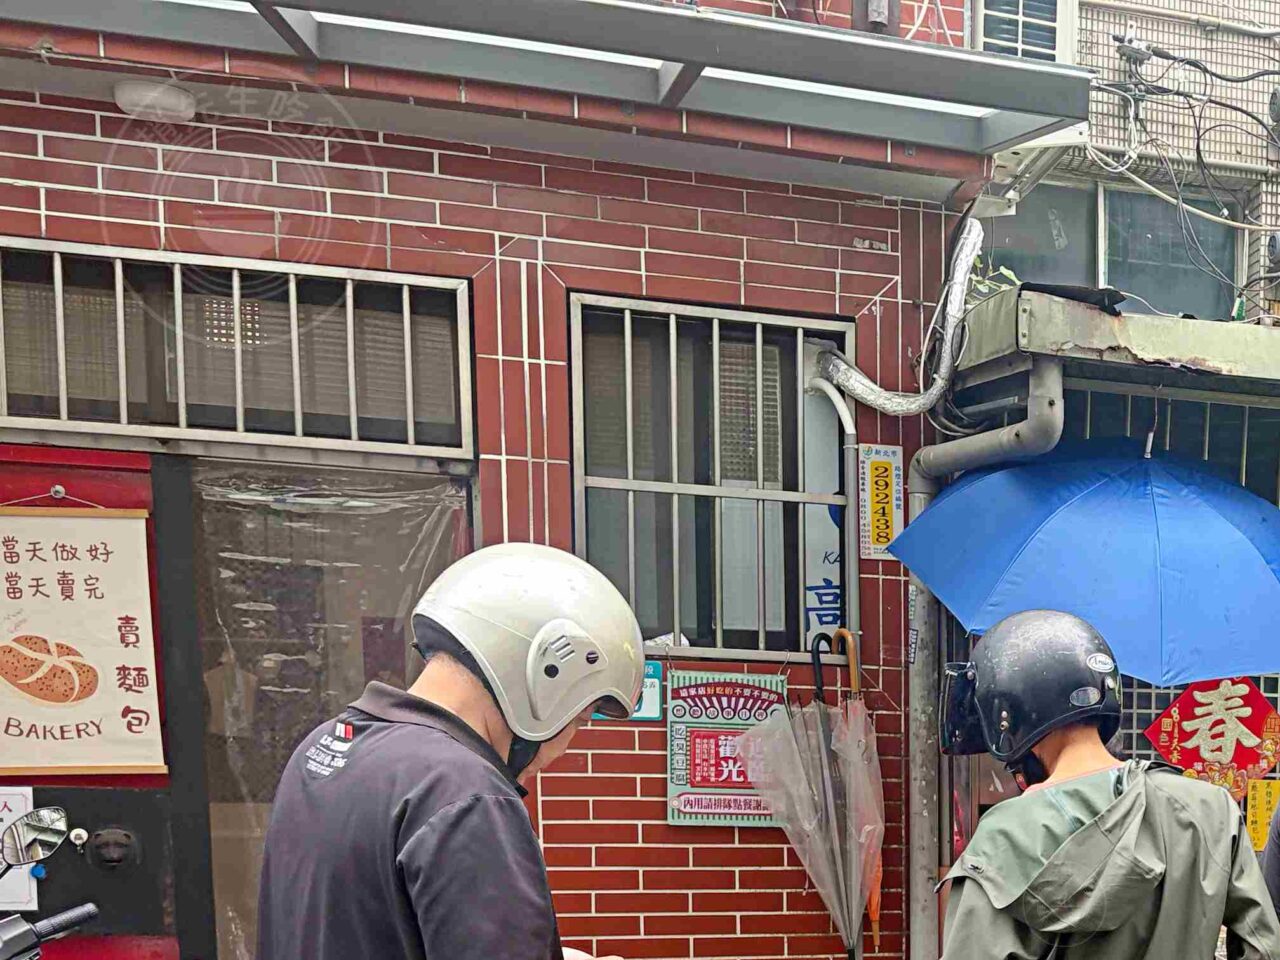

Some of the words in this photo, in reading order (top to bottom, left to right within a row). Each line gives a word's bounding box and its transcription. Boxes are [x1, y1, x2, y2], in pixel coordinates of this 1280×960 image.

[874, 465, 891, 544] 292438
[2, 535, 115, 565] 當天做好
[4, 570, 105, 602] 當天賣完
[115, 614, 151, 734] 賣麵包
[4, 717, 104, 741] BAKERY
[1179, 679, 1263, 764] 春
